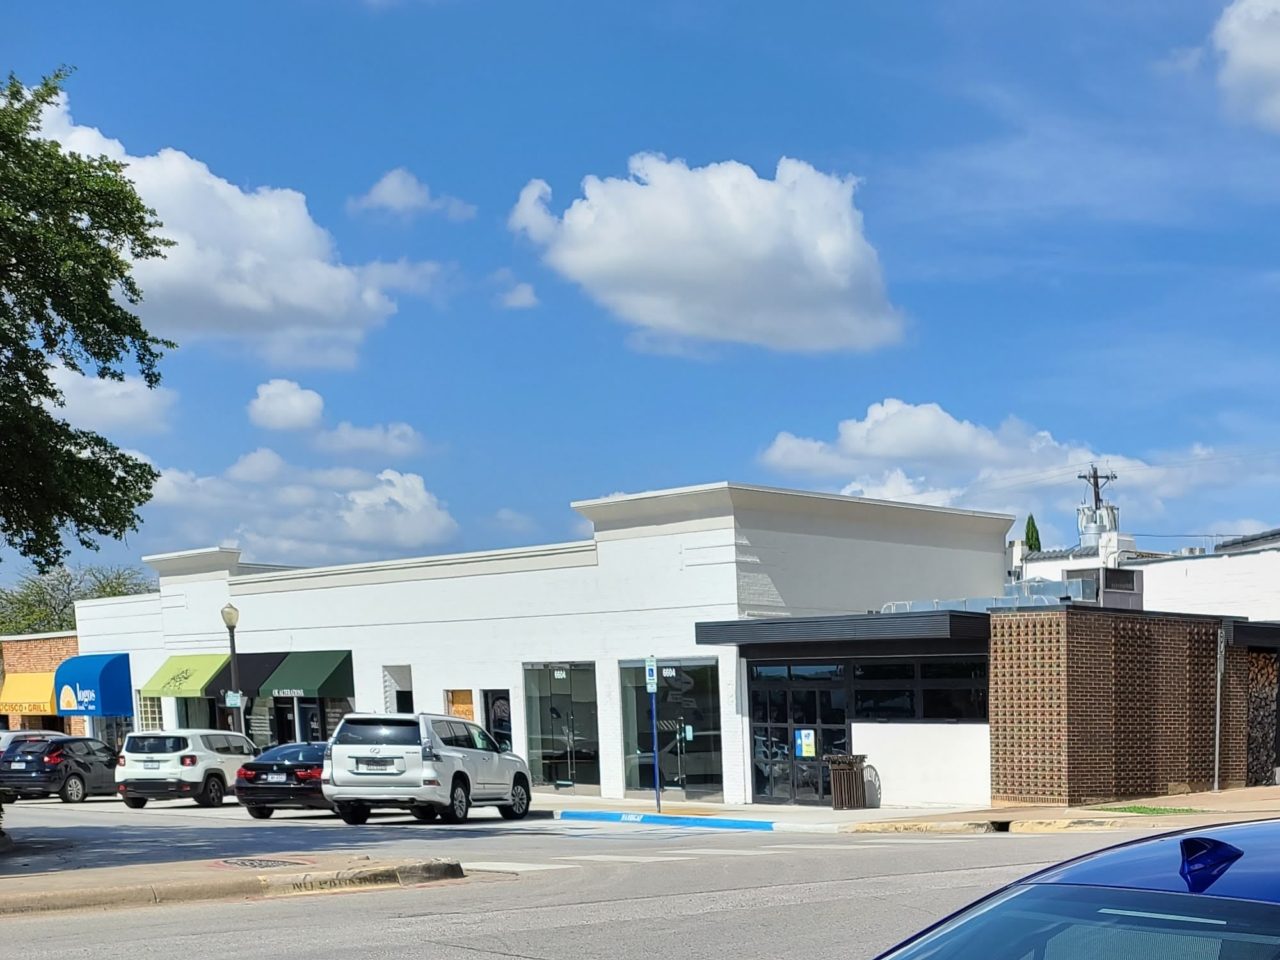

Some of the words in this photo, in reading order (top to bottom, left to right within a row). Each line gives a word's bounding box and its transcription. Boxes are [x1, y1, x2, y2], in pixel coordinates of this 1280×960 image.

[554, 670, 566, 679] 6604
[662, 667, 676, 678] 6604
[76, 682, 96, 707] logos
[28, 703, 47, 712] GRILL
